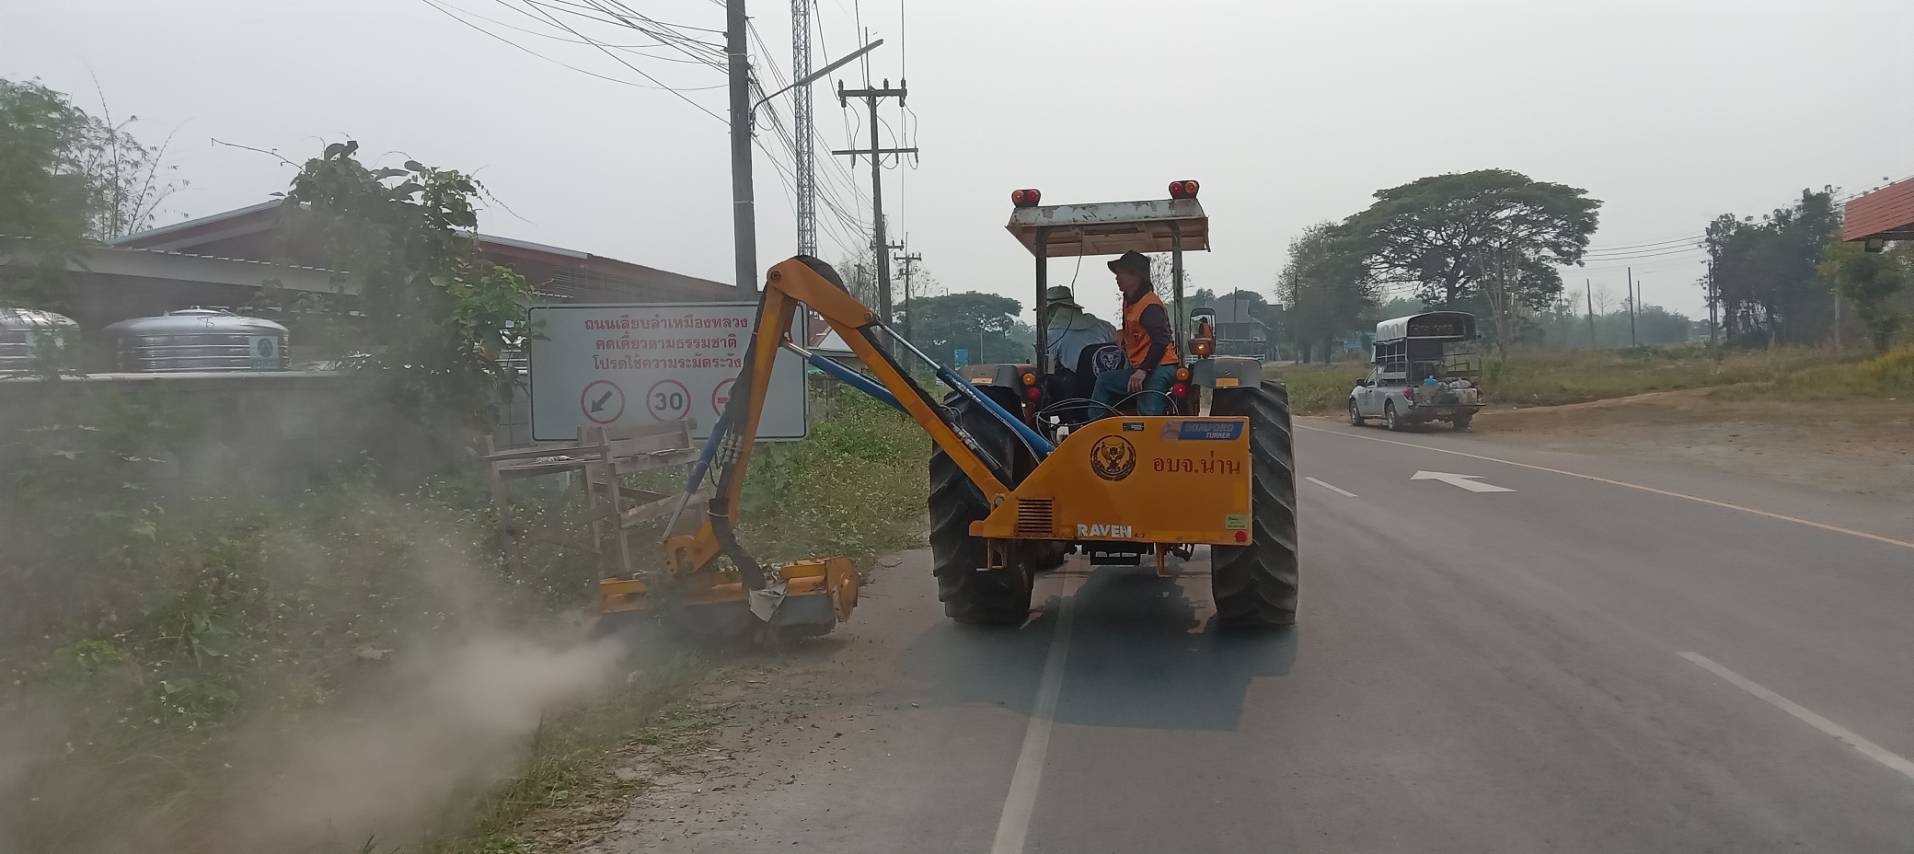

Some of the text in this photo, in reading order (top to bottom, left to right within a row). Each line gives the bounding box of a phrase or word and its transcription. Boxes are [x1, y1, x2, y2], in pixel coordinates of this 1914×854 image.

[654, 392, 683, 411] 30
[1153, 450, 1241, 474] อบจ.น่าน
[1077, 523, 1132, 538] RAVEN
